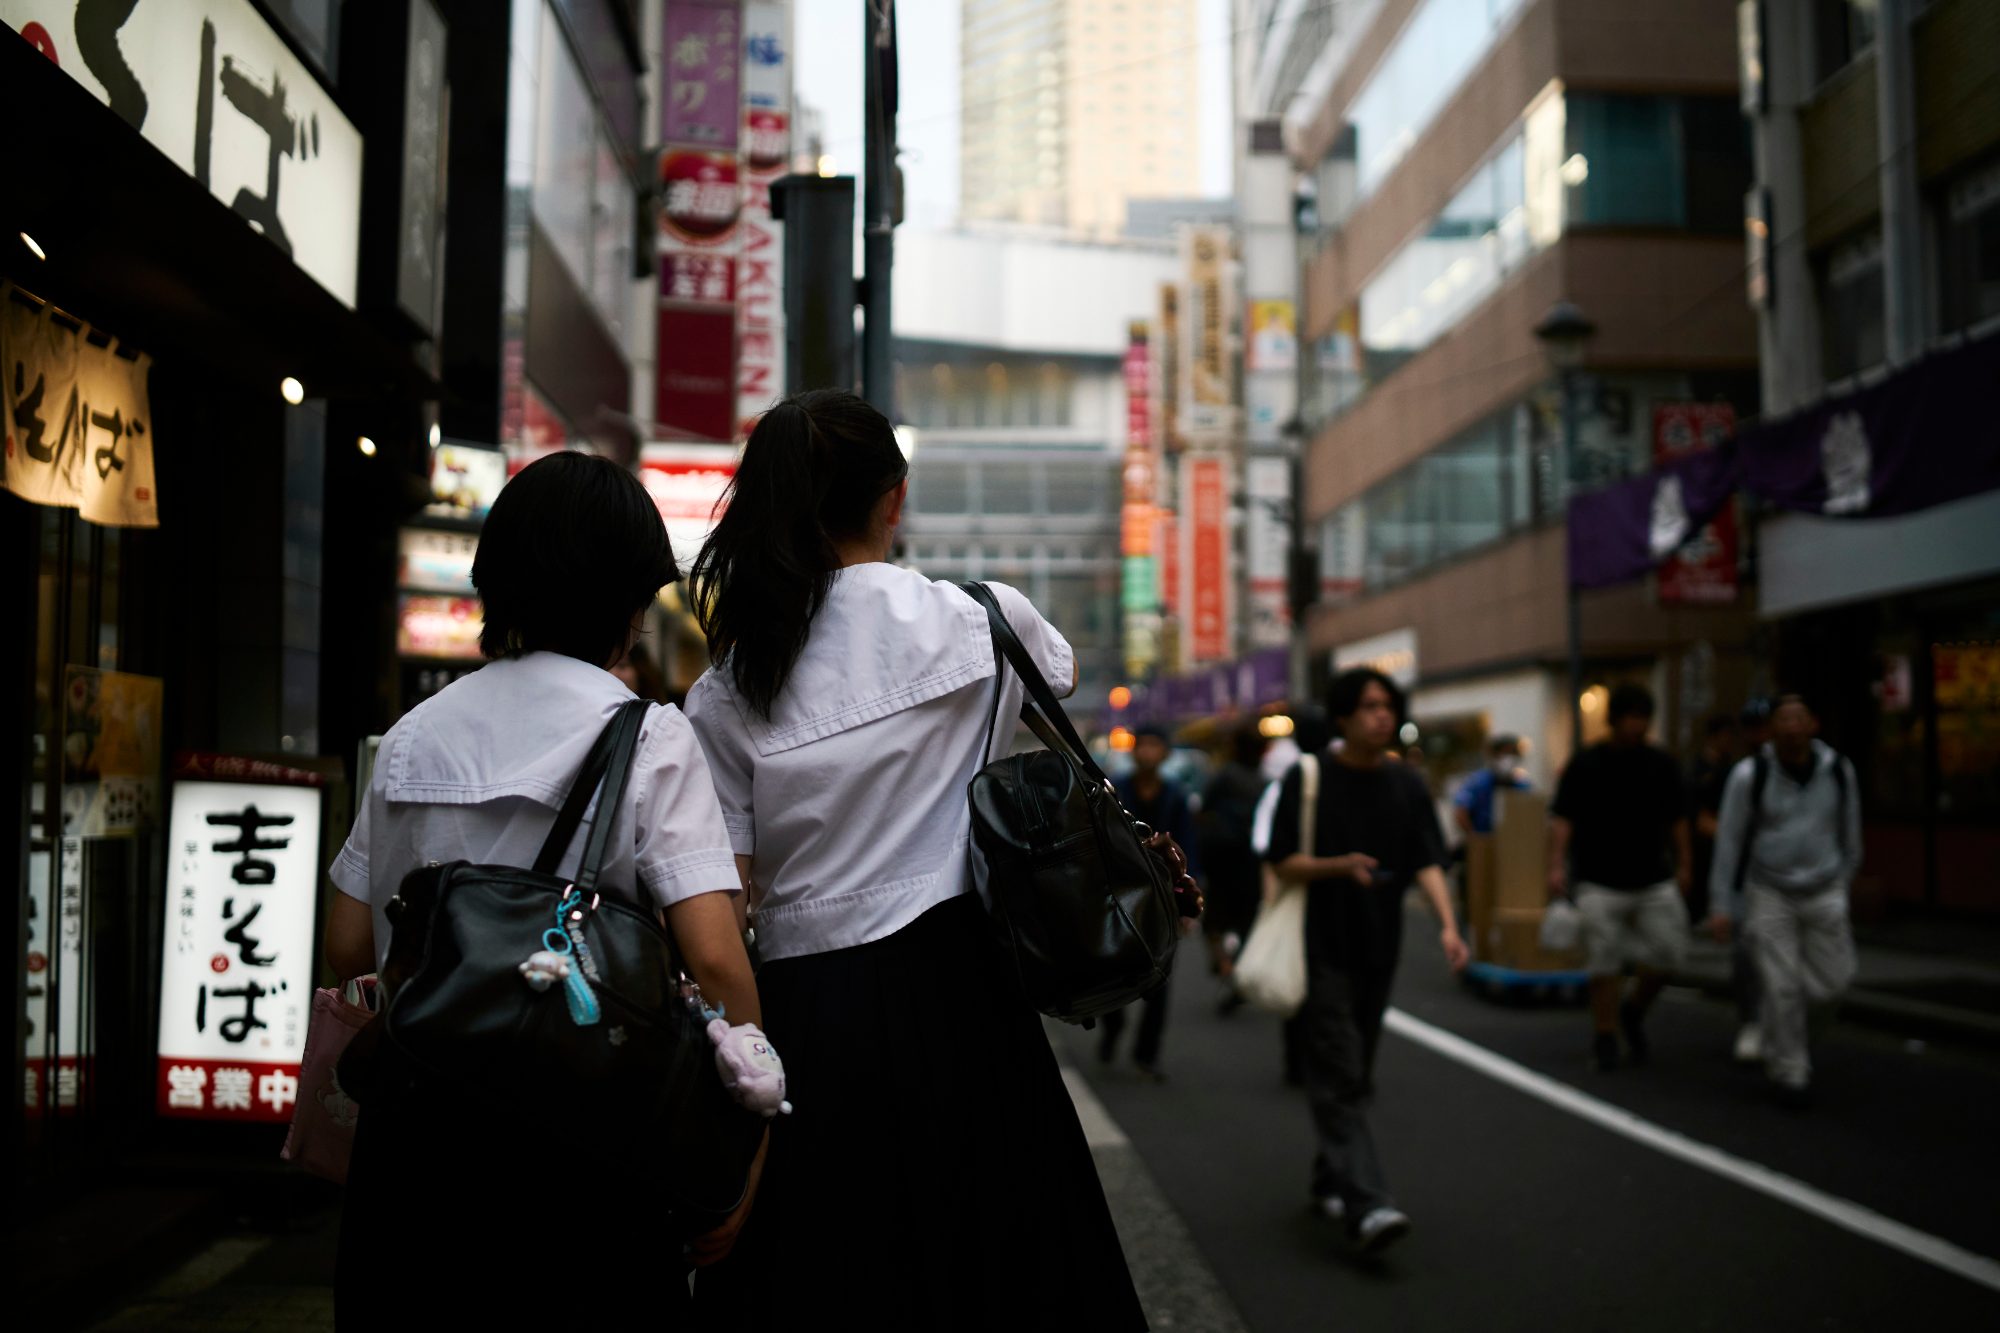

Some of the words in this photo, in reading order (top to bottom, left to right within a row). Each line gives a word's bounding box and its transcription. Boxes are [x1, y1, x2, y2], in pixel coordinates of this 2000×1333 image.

[197, 804, 294, 1042] 吉そば
[166, 1064, 299, 1114] 営業中
